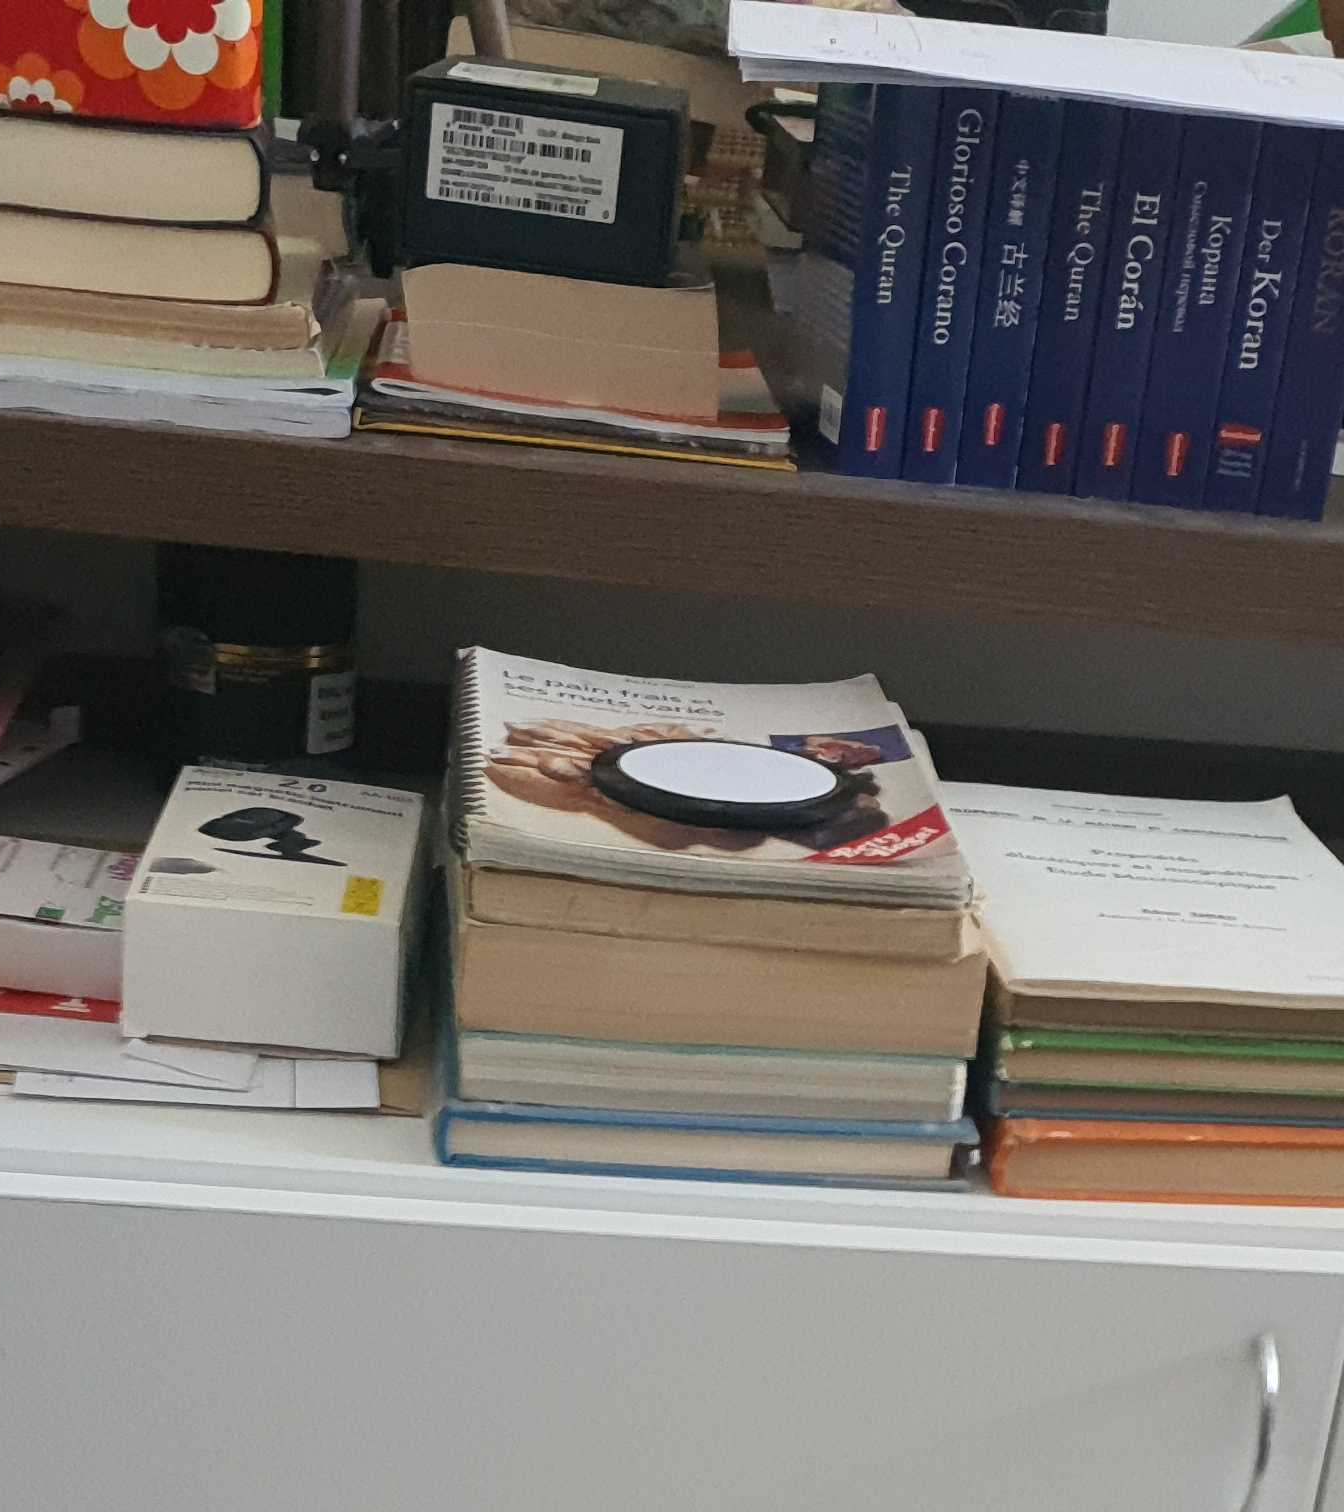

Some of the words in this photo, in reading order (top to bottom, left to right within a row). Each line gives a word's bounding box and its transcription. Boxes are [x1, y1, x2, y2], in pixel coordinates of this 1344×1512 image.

[886, 167, 912, 218] The
[944, 108, 983, 233] Glorioso
[1076, 183, 1104, 234] The
[1133, 193, 1160, 225] El
[874, 224, 906, 305] Quran
[1197, 215, 1232, 306] Корана
[1255, 220, 1283, 262] Der
[931, 242, 968, 345] Corano
[993, 242, 1028, 328] 古兰经
[1061, 242, 1095, 322] Quran
[1115, 235, 1155, 330] Corán
[1237, 269, 1282, 370] Koran
[502, 669, 536, 682] Le
[545, 678, 610, 695] pain
[618, 689, 683, 703] frais
[690, 697, 714, 706] et
[503, 681, 548, 695] ses
[639, 702, 726, 717] variés
